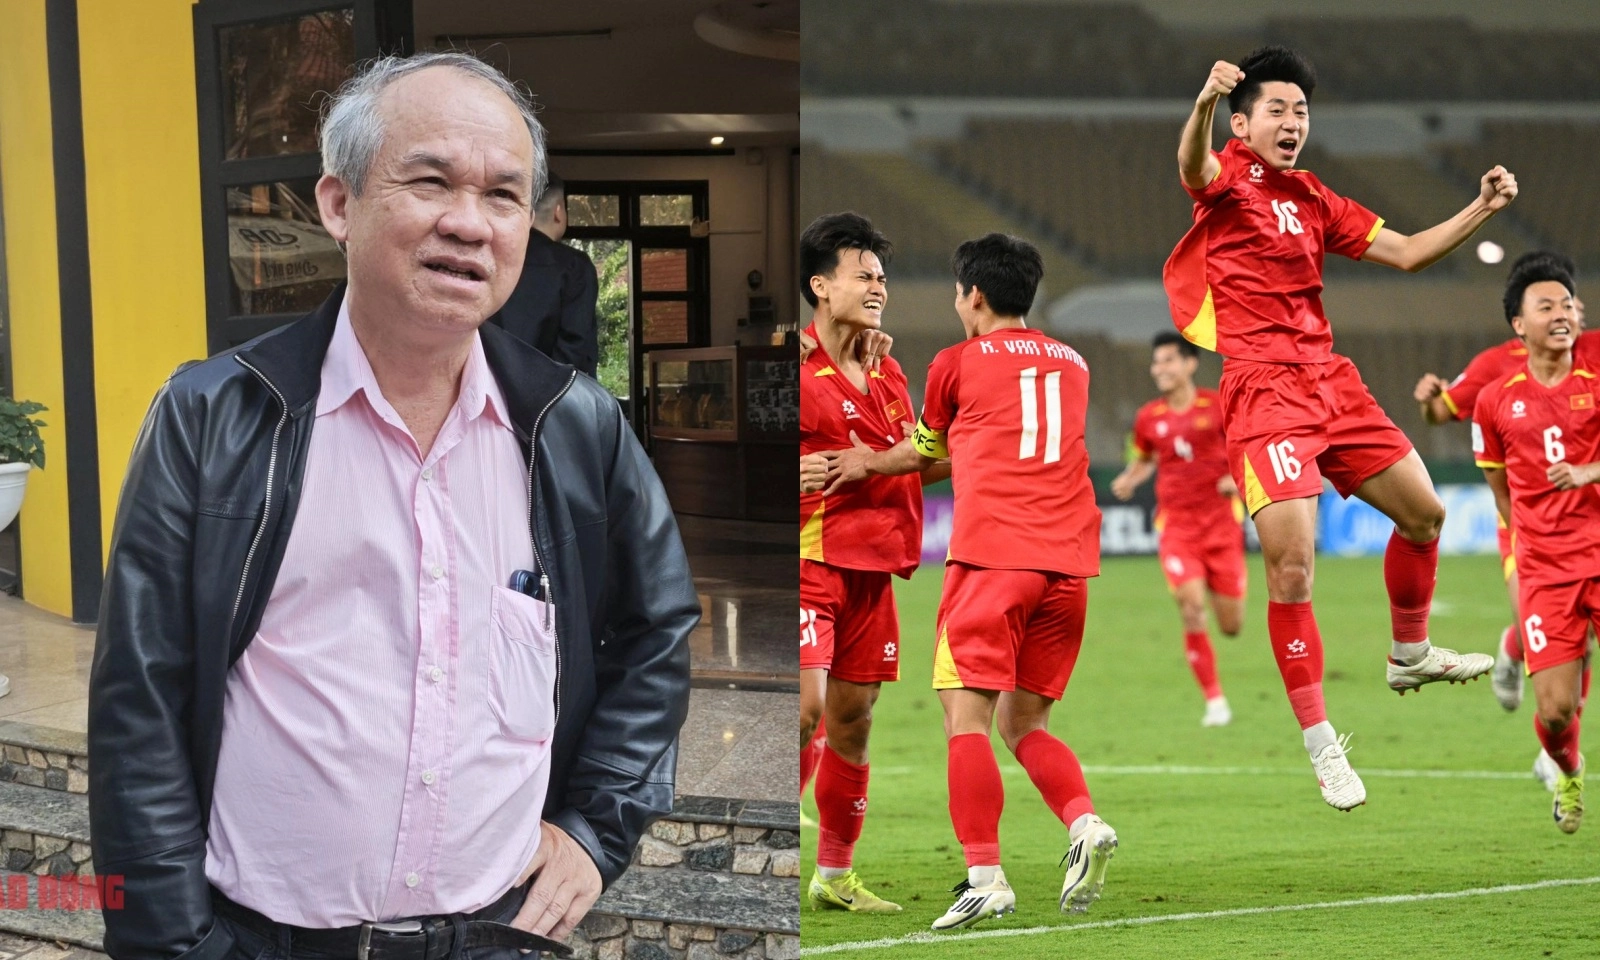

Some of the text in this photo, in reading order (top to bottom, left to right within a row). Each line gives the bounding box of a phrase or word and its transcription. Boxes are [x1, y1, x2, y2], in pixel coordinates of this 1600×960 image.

[1271, 199, 1305, 236] 16
[980, 340, 999, 354] K.
[1019, 366, 1062, 464] 11
[913, 428, 936, 452] AFC
[1543, 425, 1566, 464] 6
[1267, 440, 1301, 485] 16
[1525, 613, 1548, 653] 6
